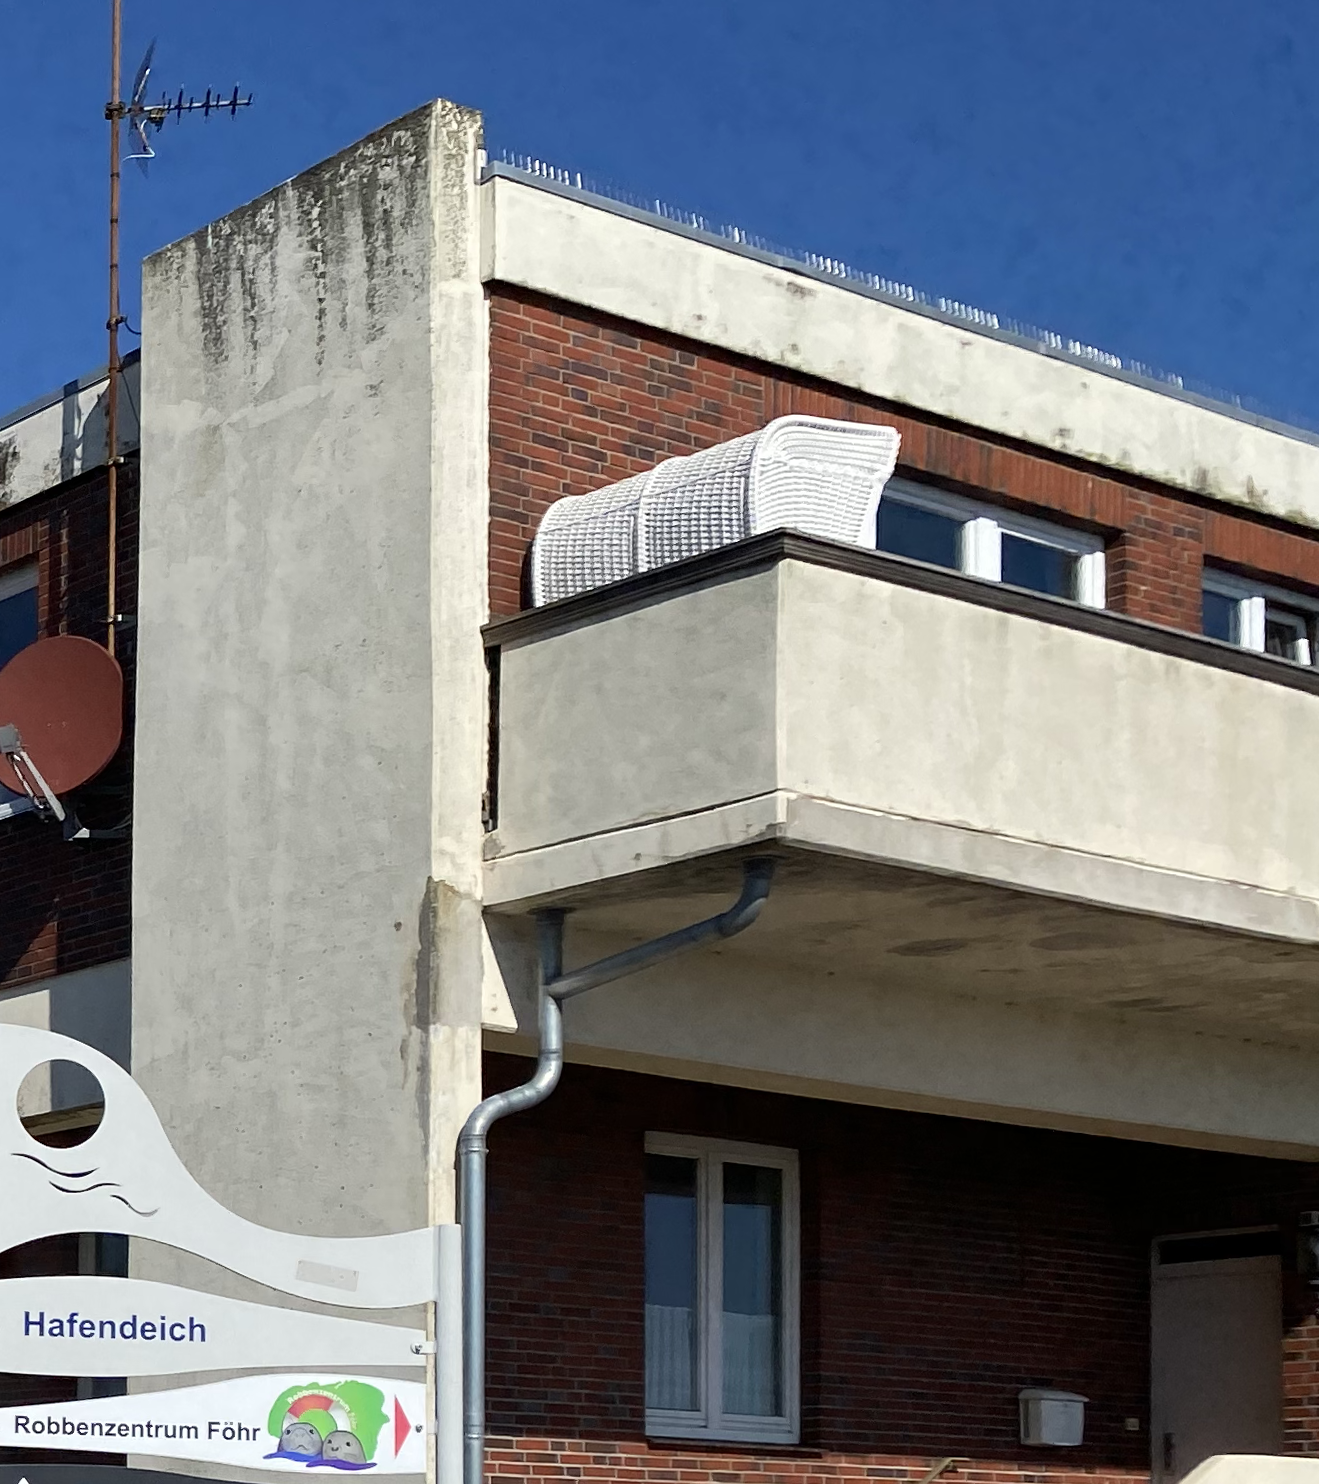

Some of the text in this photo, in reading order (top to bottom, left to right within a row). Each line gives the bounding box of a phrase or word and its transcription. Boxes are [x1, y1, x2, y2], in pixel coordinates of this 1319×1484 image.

[23, 1310, 207, 1343] Hafendeich
[13, 1415, 262, 1442] Robbenzentrum Föhr
